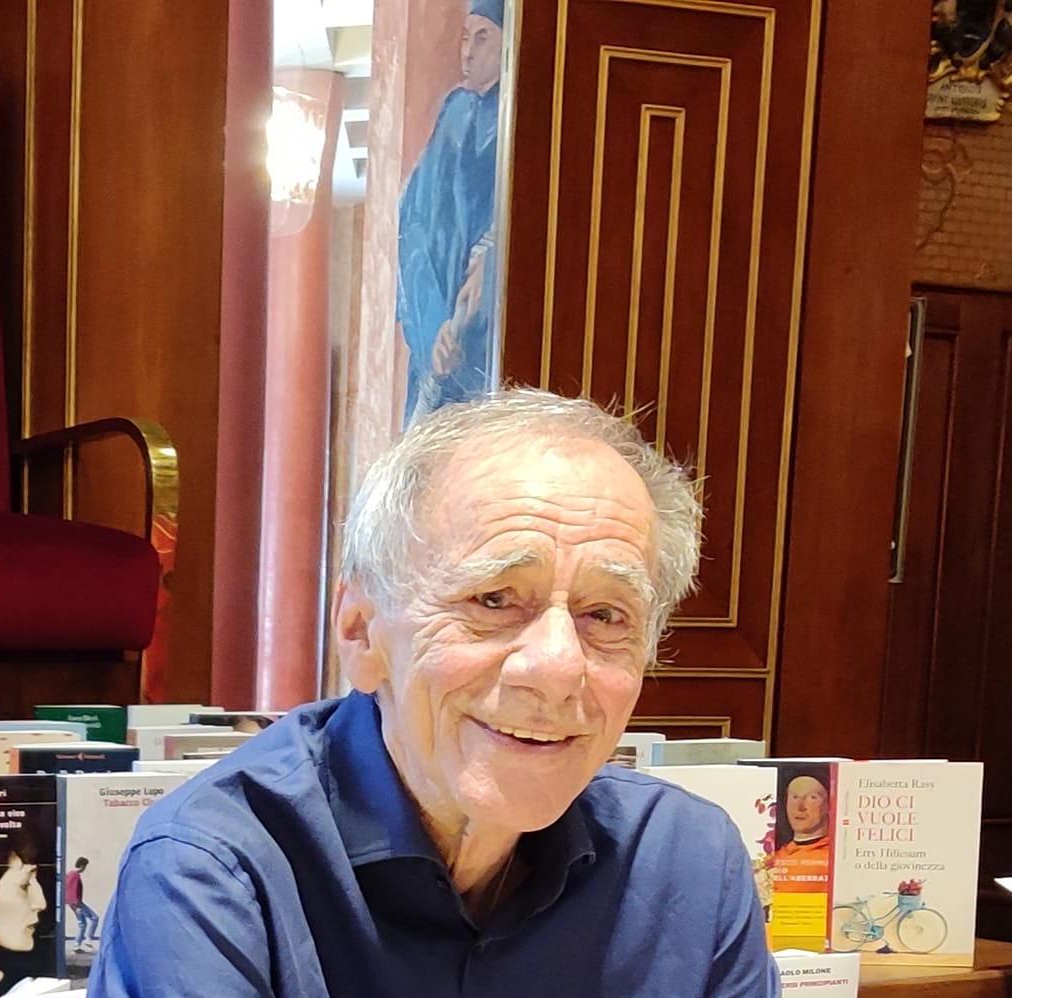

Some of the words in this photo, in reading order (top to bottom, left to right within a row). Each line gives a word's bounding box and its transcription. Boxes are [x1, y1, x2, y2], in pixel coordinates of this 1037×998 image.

[859, 778, 908, 788] Elisabetta
[99, 786, 140, 798] Giuseppe
[103, 798, 140, 808] Tabacco
[858, 795, 891, 809] DIO
[895, 795, 914, 809] CI
[857, 811, 919, 826] VUOLE
[857, 828, 914, 842] FELICI
[879, 848, 926, 859] Hillesum
[854, 862, 862, 870] o
[864, 861, 888, 870] della
[890, 862, 945, 872] giovinezza
[780, 968, 800, 977] AOLO
[802, 967, 831, 976] MILONE
